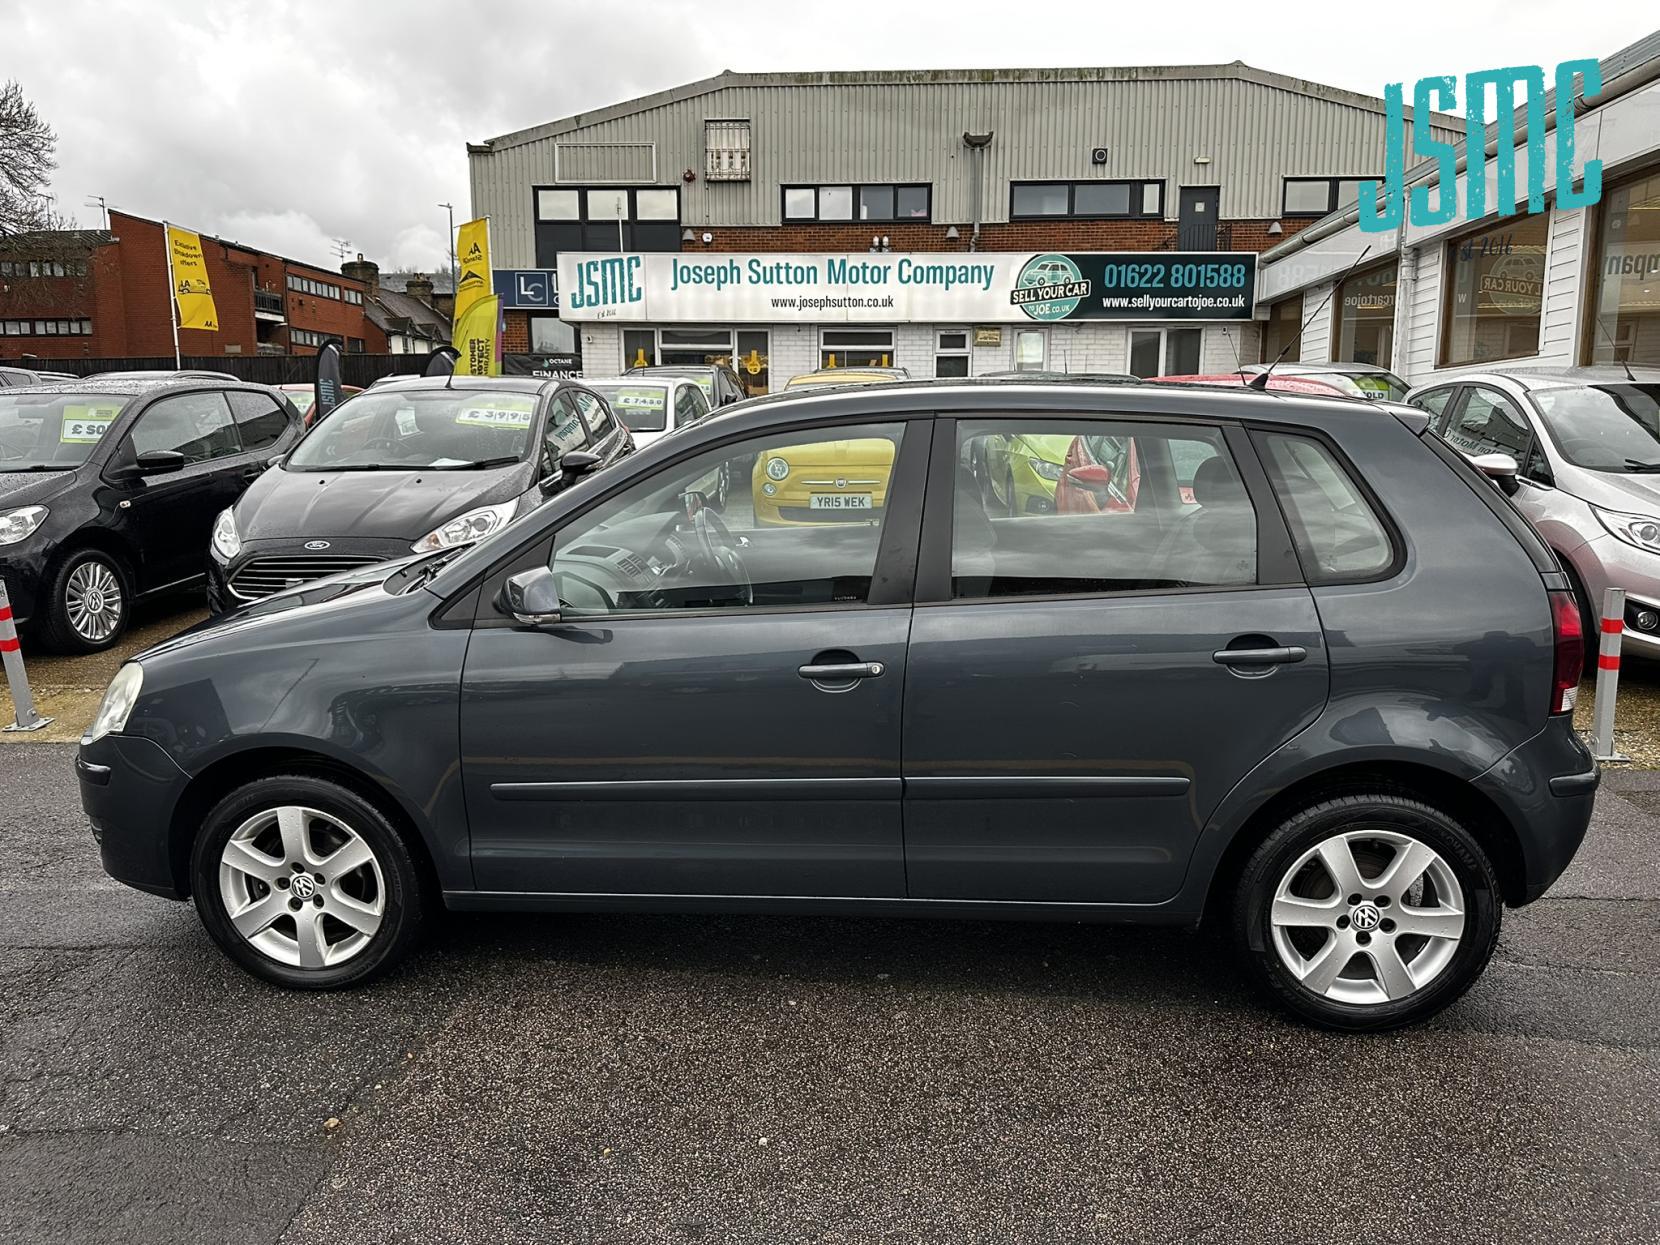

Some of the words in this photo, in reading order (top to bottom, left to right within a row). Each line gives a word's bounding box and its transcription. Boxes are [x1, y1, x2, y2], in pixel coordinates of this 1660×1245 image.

[570, 256, 642, 309] JSMC
[671, 258, 741, 291] Joseph
[748, 258, 818, 284] Sutton
[827, 258, 892, 284] Motor
[898, 258, 995, 291] Company
[1104, 263, 1165, 288] 01622
[1170, 263, 1246, 288] 801588
[1013, 290, 1036, 303] SELL
[1037, 285, 1065, 300] YOUR
[1065, 283, 1087, 296] CAR
[771, 295, 894, 311] www.josephsutton.co.uk
[1102, 294, 1246, 311] www.sellyourcartojoe.co.uk
[1362, 391, 1385, 399] OLD
[468, 411, 480, 419] £
[71, 424, 82, 435] £
[86, 424, 110, 435] SO
[816, 496, 841, 508] YR15
[843, 495, 865, 508] WEK
